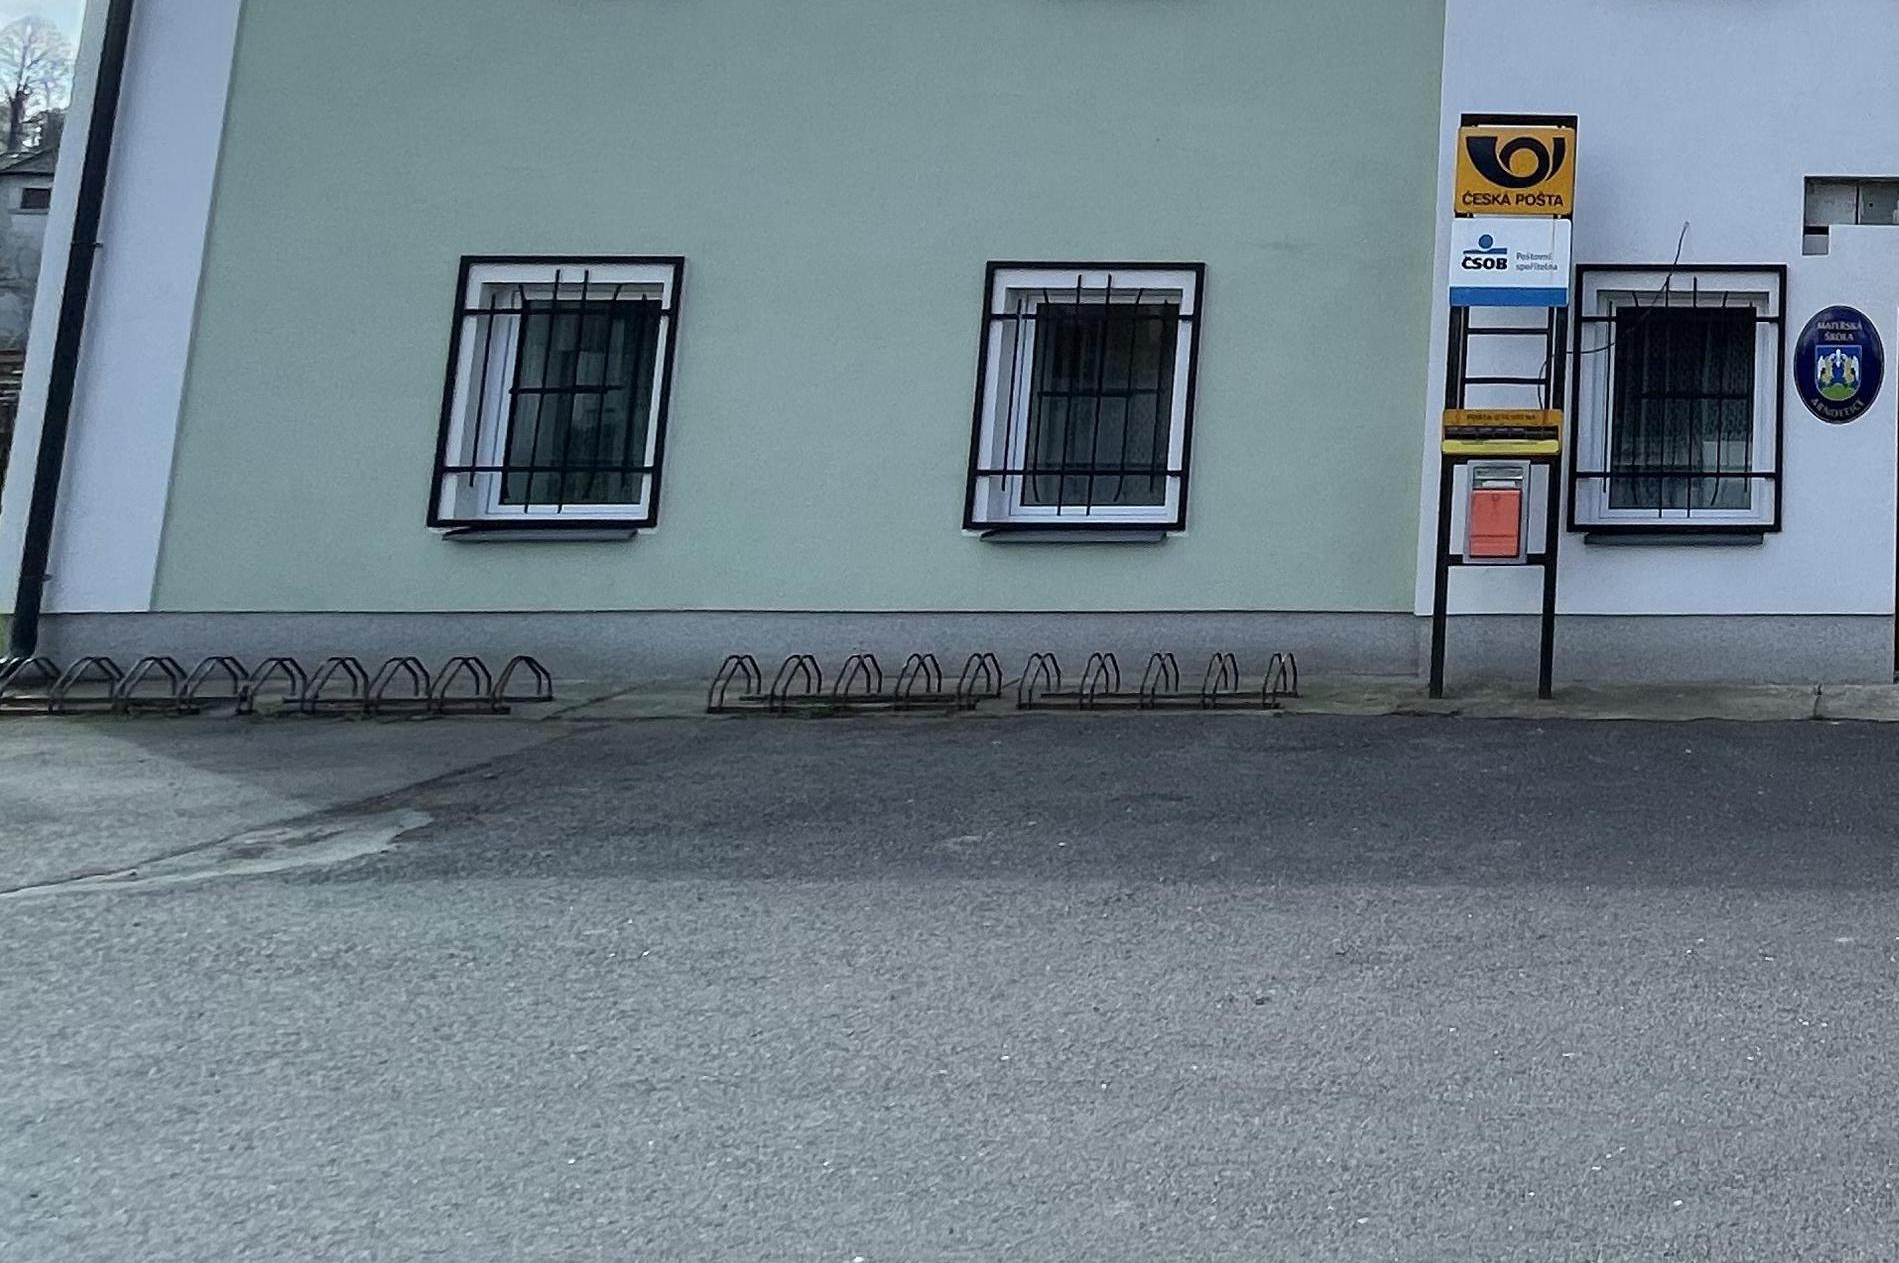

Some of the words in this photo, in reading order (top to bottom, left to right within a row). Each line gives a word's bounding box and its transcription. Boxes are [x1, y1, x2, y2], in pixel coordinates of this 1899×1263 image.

[1515, 191, 1564, 207] POŠTA
[1461, 256, 1508, 270] ČSOB
[1824, 331, 1854, 342] ŠKOLA
